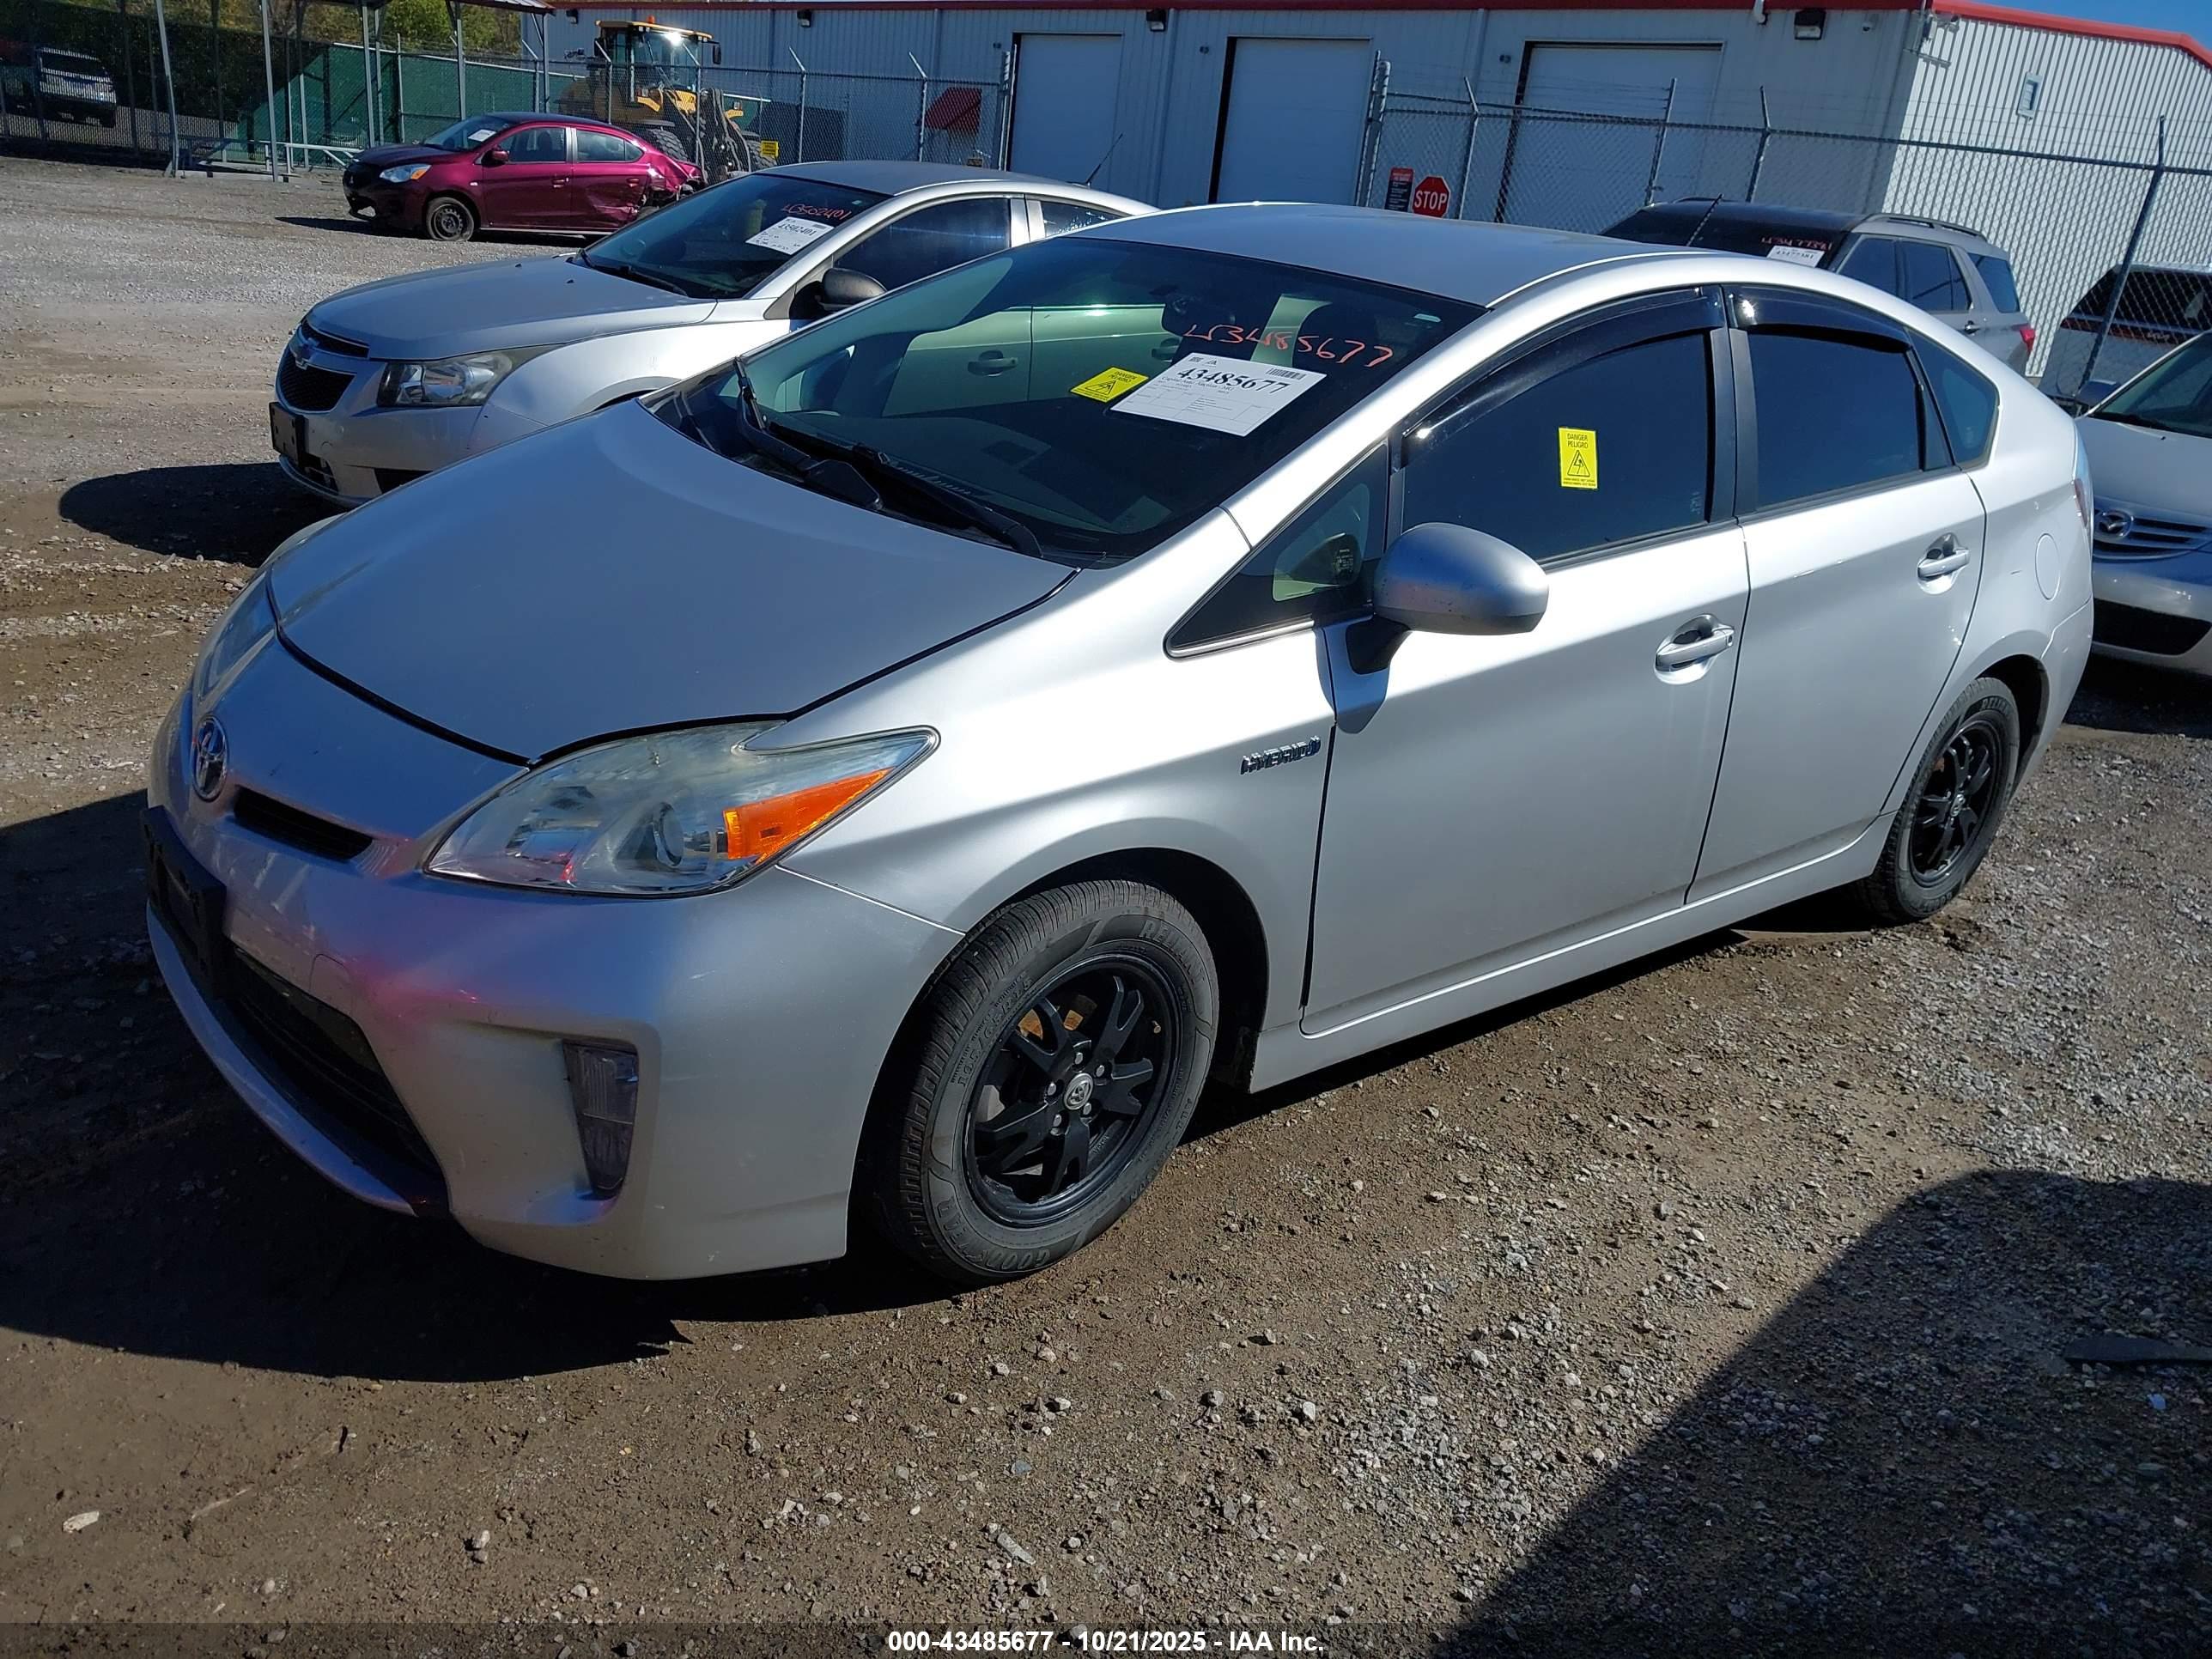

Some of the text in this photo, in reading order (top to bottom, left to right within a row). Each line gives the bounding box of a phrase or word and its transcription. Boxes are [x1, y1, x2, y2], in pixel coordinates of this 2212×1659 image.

[1413, 190, 1448, 210] STOP
[1183, 323, 1394, 368] 43485677
[1176, 367, 1291, 395] 43485677
[1240, 735, 1322, 775] HYBRID
